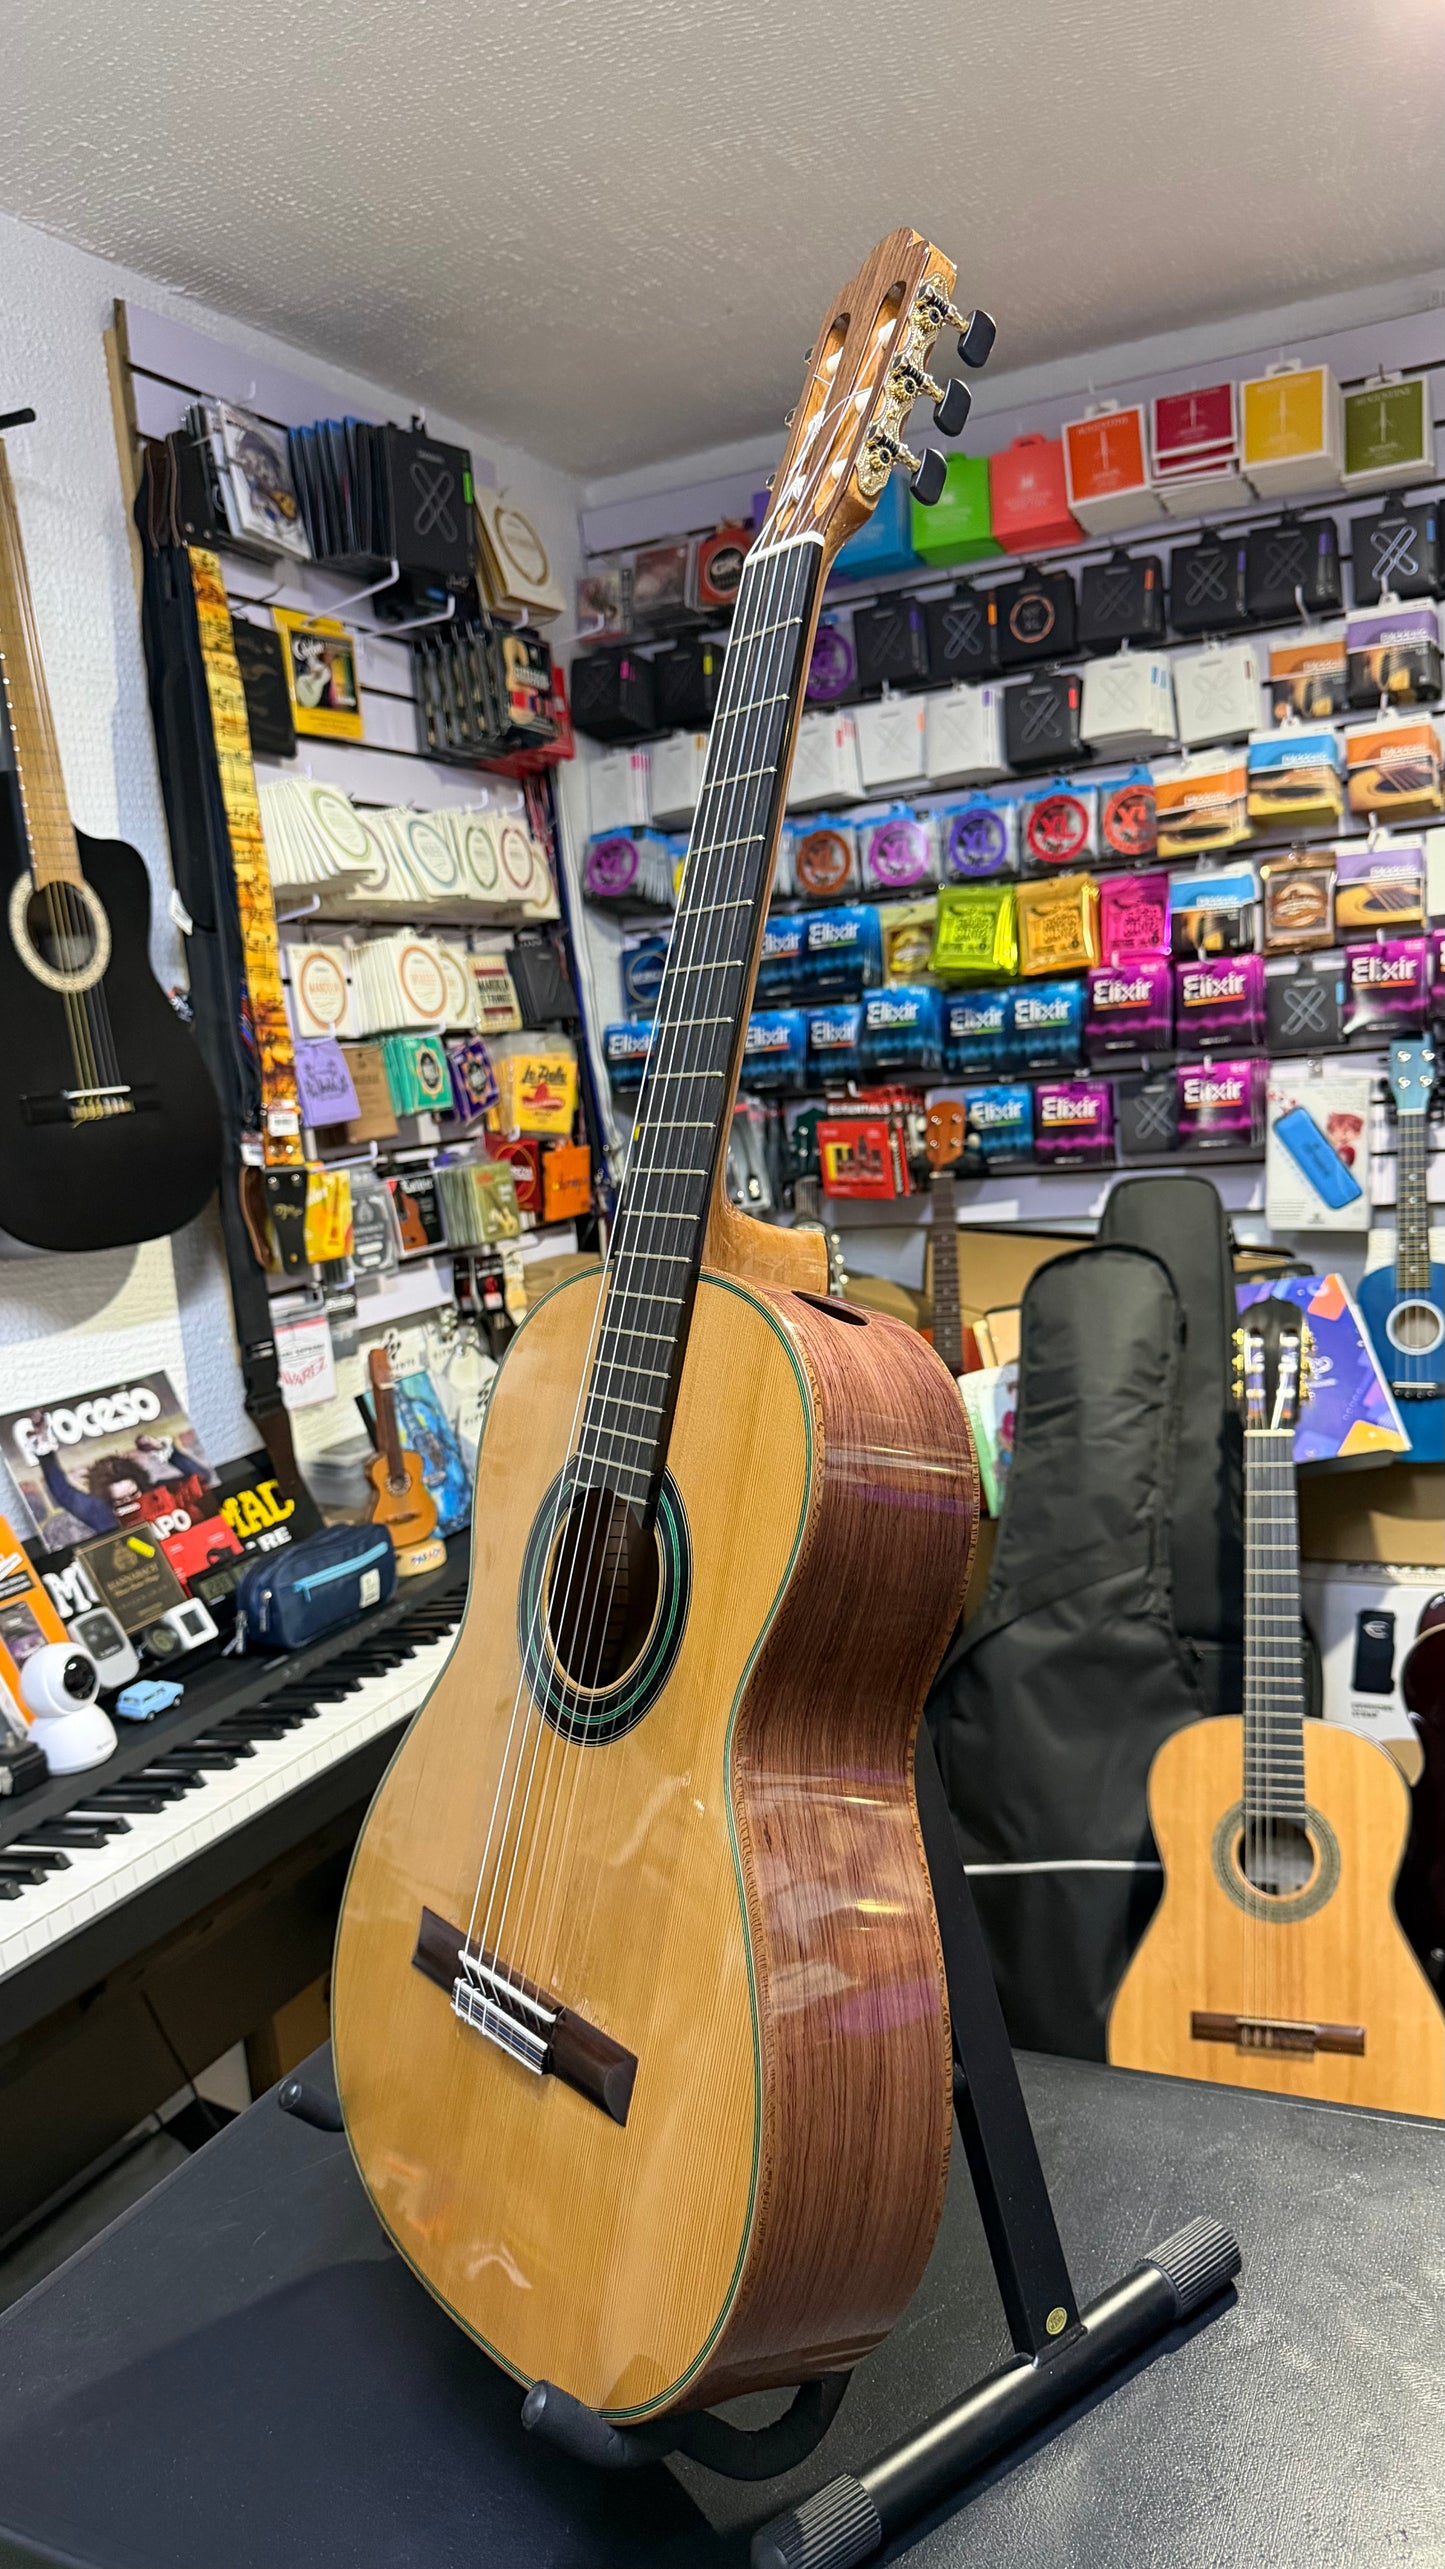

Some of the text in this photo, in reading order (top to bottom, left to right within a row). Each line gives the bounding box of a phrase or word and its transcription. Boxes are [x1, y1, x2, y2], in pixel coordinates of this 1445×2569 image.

[808, 919, 861, 946] Elixir
[1092, 977, 1155, 1007] Elixir
[1183, 969, 1247, 1001] Elixir
[866, 1000, 920, 1027] Elixir
[950, 1006, 1005, 1034] Elixir
[1014, 997, 1073, 1025] Elixir
[1184, 1074, 1246, 1104] Elixir
[1041, 1095, 1099, 1121] Elixir
